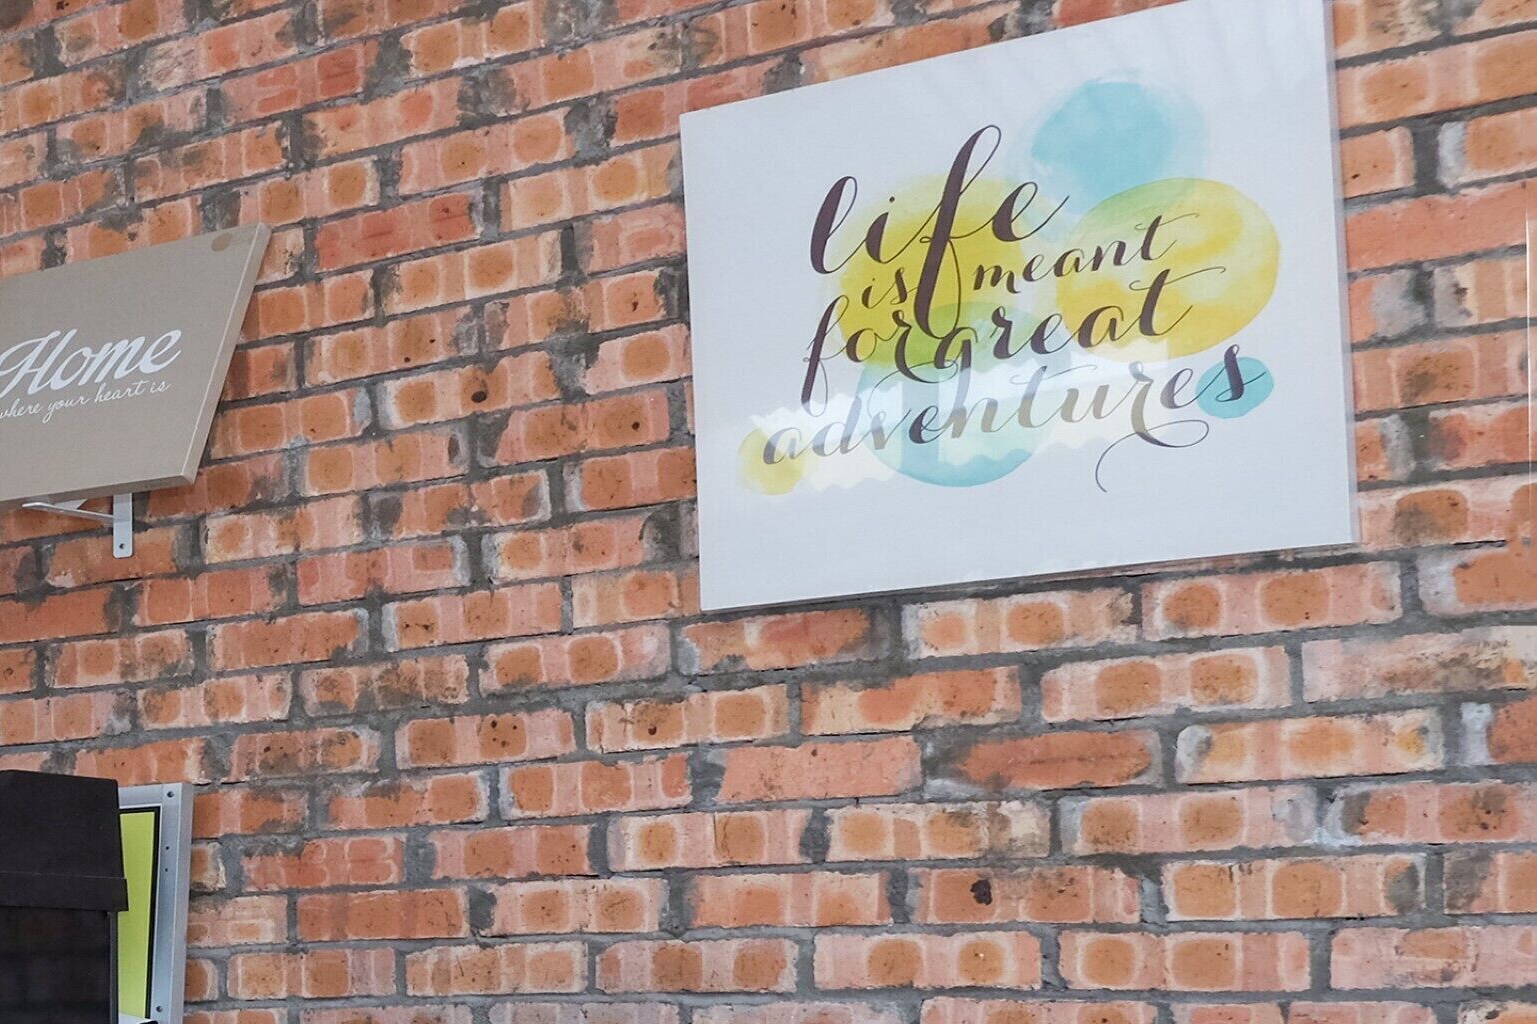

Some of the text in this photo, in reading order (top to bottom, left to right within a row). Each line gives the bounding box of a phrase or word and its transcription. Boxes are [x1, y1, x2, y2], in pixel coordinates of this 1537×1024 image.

[809, 125, 1069, 340] life
[861, 213, 1199, 309] is meant
[42, 396, 89, 424] your
[95, 381, 146, 404] heart
[150, 380, 171, 395] is
[763, 342, 1266, 492] adventures
[801, 266, 1228, 419] for great
